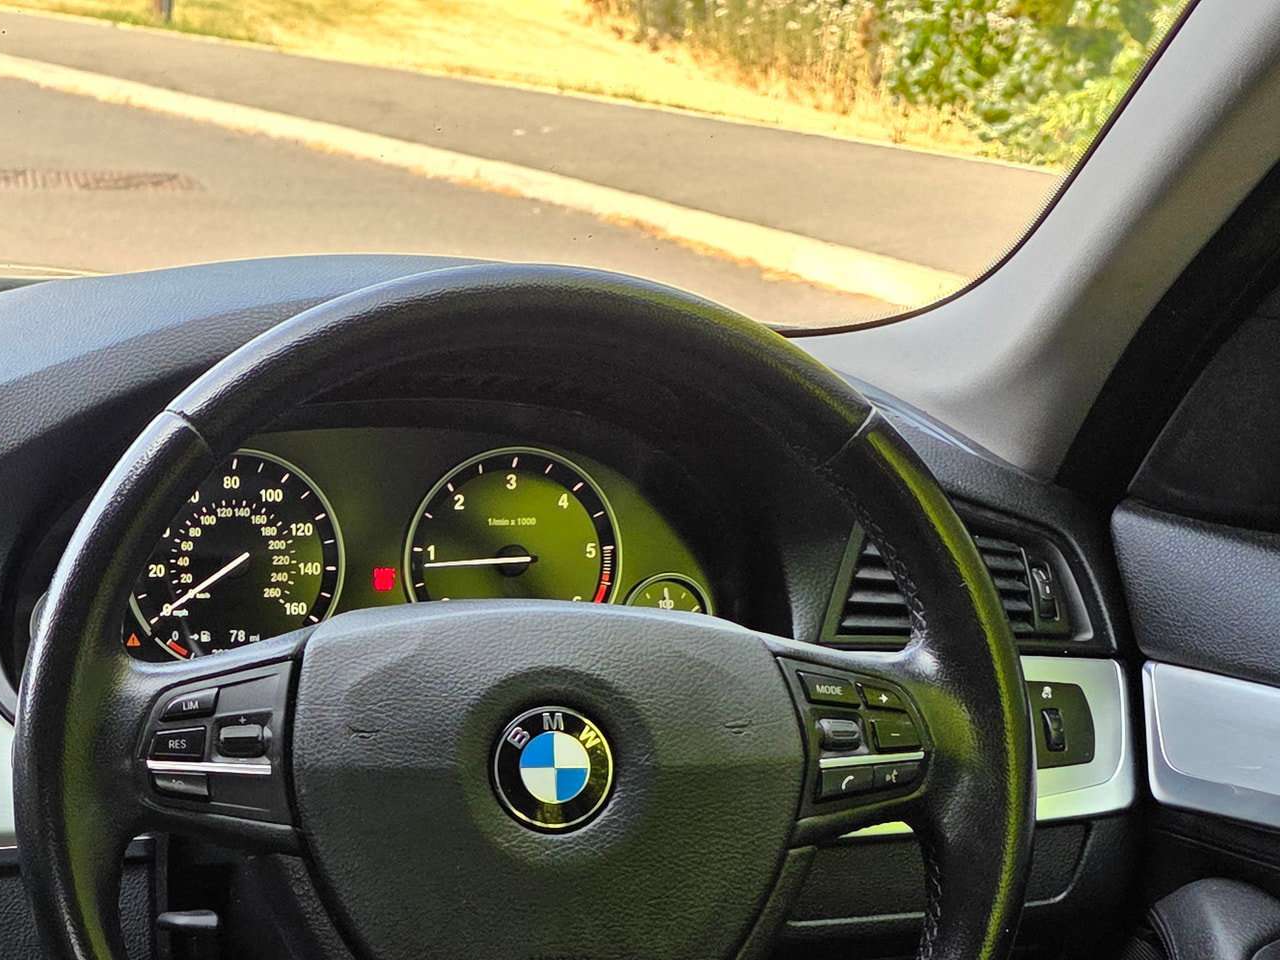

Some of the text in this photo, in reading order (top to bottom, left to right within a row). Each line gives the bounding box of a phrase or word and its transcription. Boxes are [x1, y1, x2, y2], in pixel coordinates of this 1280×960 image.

[223, 475, 240, 489] 80
[506, 473, 517, 490] 3
[259, 488, 283, 502] 100
[453, 494, 465, 511] 2
[558, 493, 569, 510] 4
[216, 507, 233, 518] 120
[234, 507, 251, 517] 140
[200, 515, 217, 525] 100
[251, 515, 267, 525] 160
[517, 517, 537, 526] 1000
[188, 527, 202, 537] 80
[260, 526, 278, 537] 180
[290, 523, 313, 537] 120
[181, 541, 194, 551] 60
[268, 540, 286, 550] 200
[426, 544, 436, 561] 1
[585, 543, 596, 559] 5
[177, 557, 190, 567] 40
[272, 556, 290, 566] 220
[148, 564, 165, 578] 20
[298, 562, 321, 576] 140
[180, 574, 193, 584] 20
[270, 572, 288, 583] 240
[263, 588, 282, 598] 260
[284, 602, 307, 616] 160
[172, 631, 180, 641] 0
[229, 629, 246, 643] 78
[816, 684, 843, 696] MODE
[182, 700, 199, 711] LIM
[507, 712, 601, 749] BMW
[168, 739, 187, 750] RES
